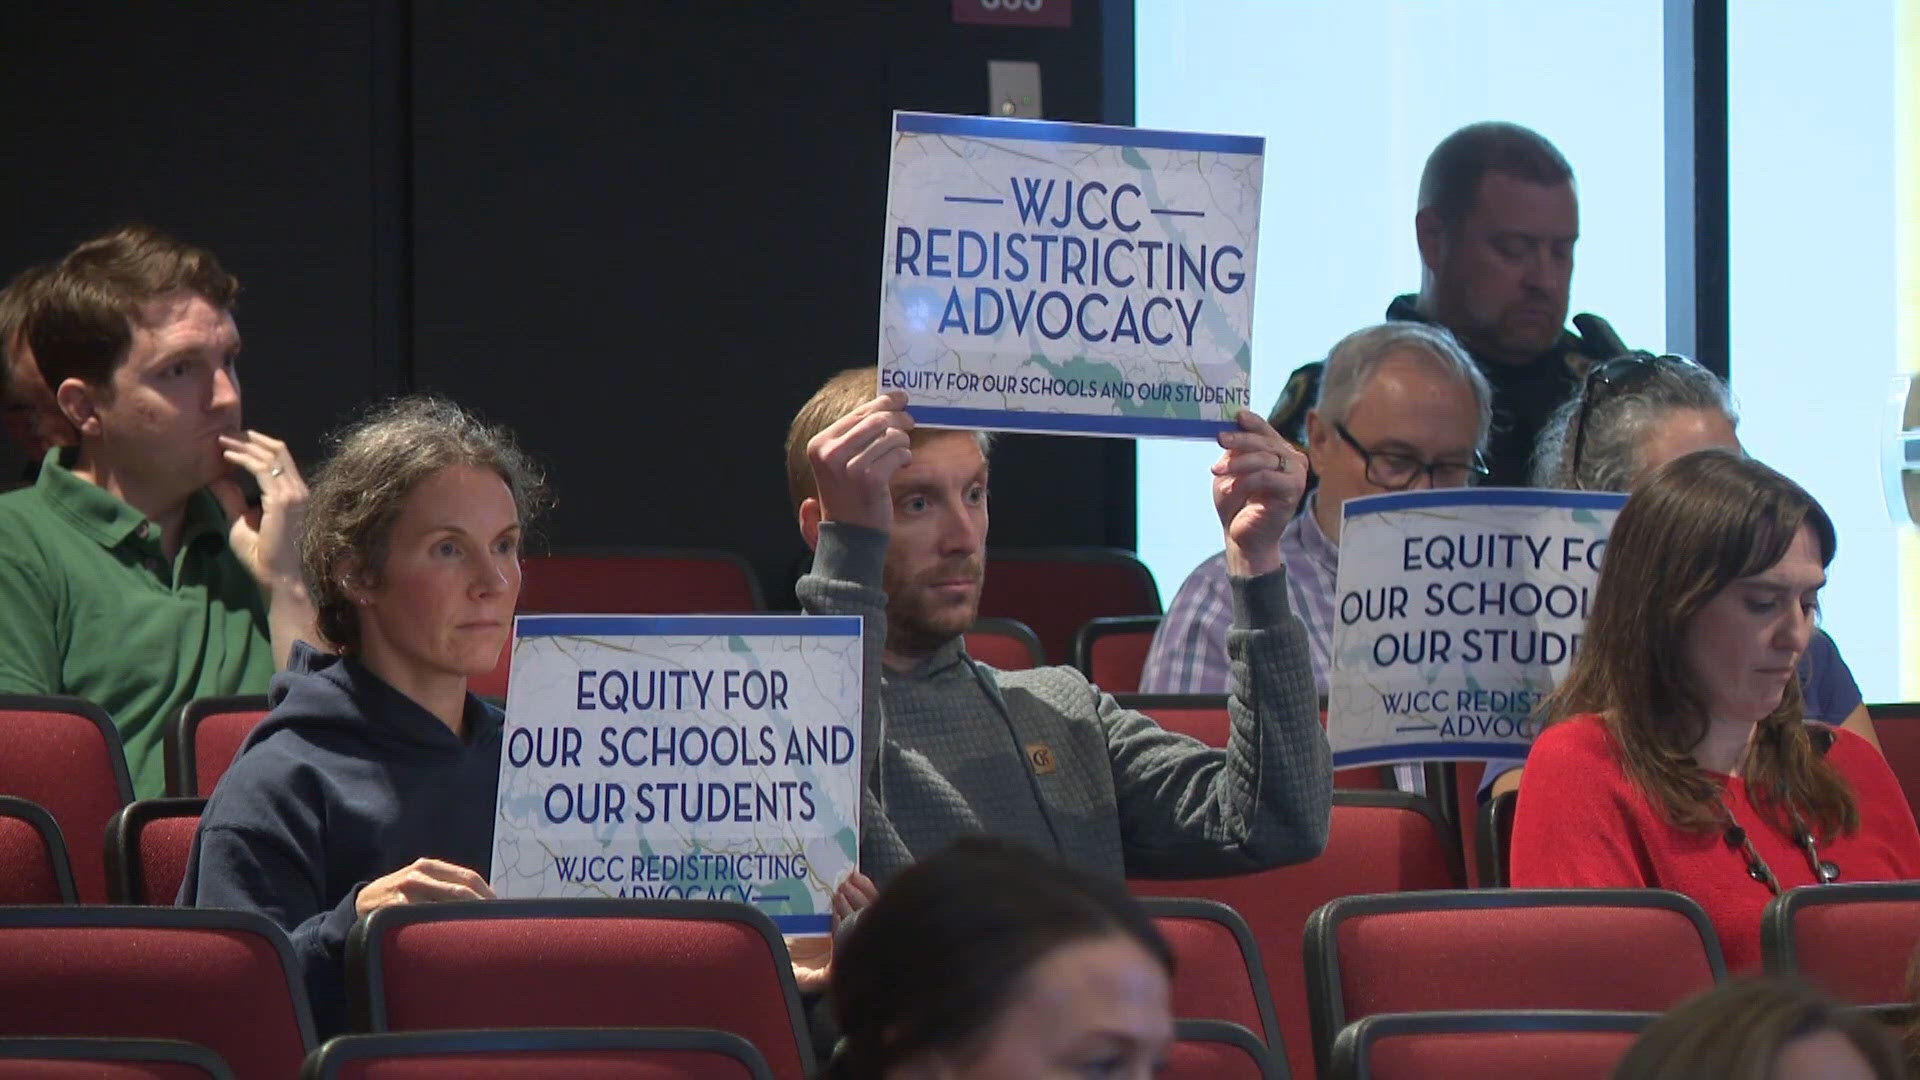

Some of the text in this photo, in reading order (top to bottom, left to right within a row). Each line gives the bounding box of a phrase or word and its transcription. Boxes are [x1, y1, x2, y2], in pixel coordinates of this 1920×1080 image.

[1010, 177, 1141, 232] WJCC
[895, 227, 1245, 294] REDISTRICTING
[938, 286, 1203, 346] ADVOCACY
[881, 368, 1250, 406] EQUITY FOR OUR SCHOOLS AND OUR STUDENTS
[1403, 534, 1608, 573] EQUITY FO
[1340, 582, 1588, 626] OUR SCHOOL
[1373, 630, 1452, 668] OUR
[576, 669, 789, 714] EQUITY FOR
[1381, 690, 1547, 715] WJCC REDIST
[508, 725, 855, 768] OUR SCHOOLS AND
[1439, 715, 1532, 739] ADVOC
[544, 781, 816, 825] OUR STUDENTS
[554, 853, 808, 882] WJCC REDISTRICTING
